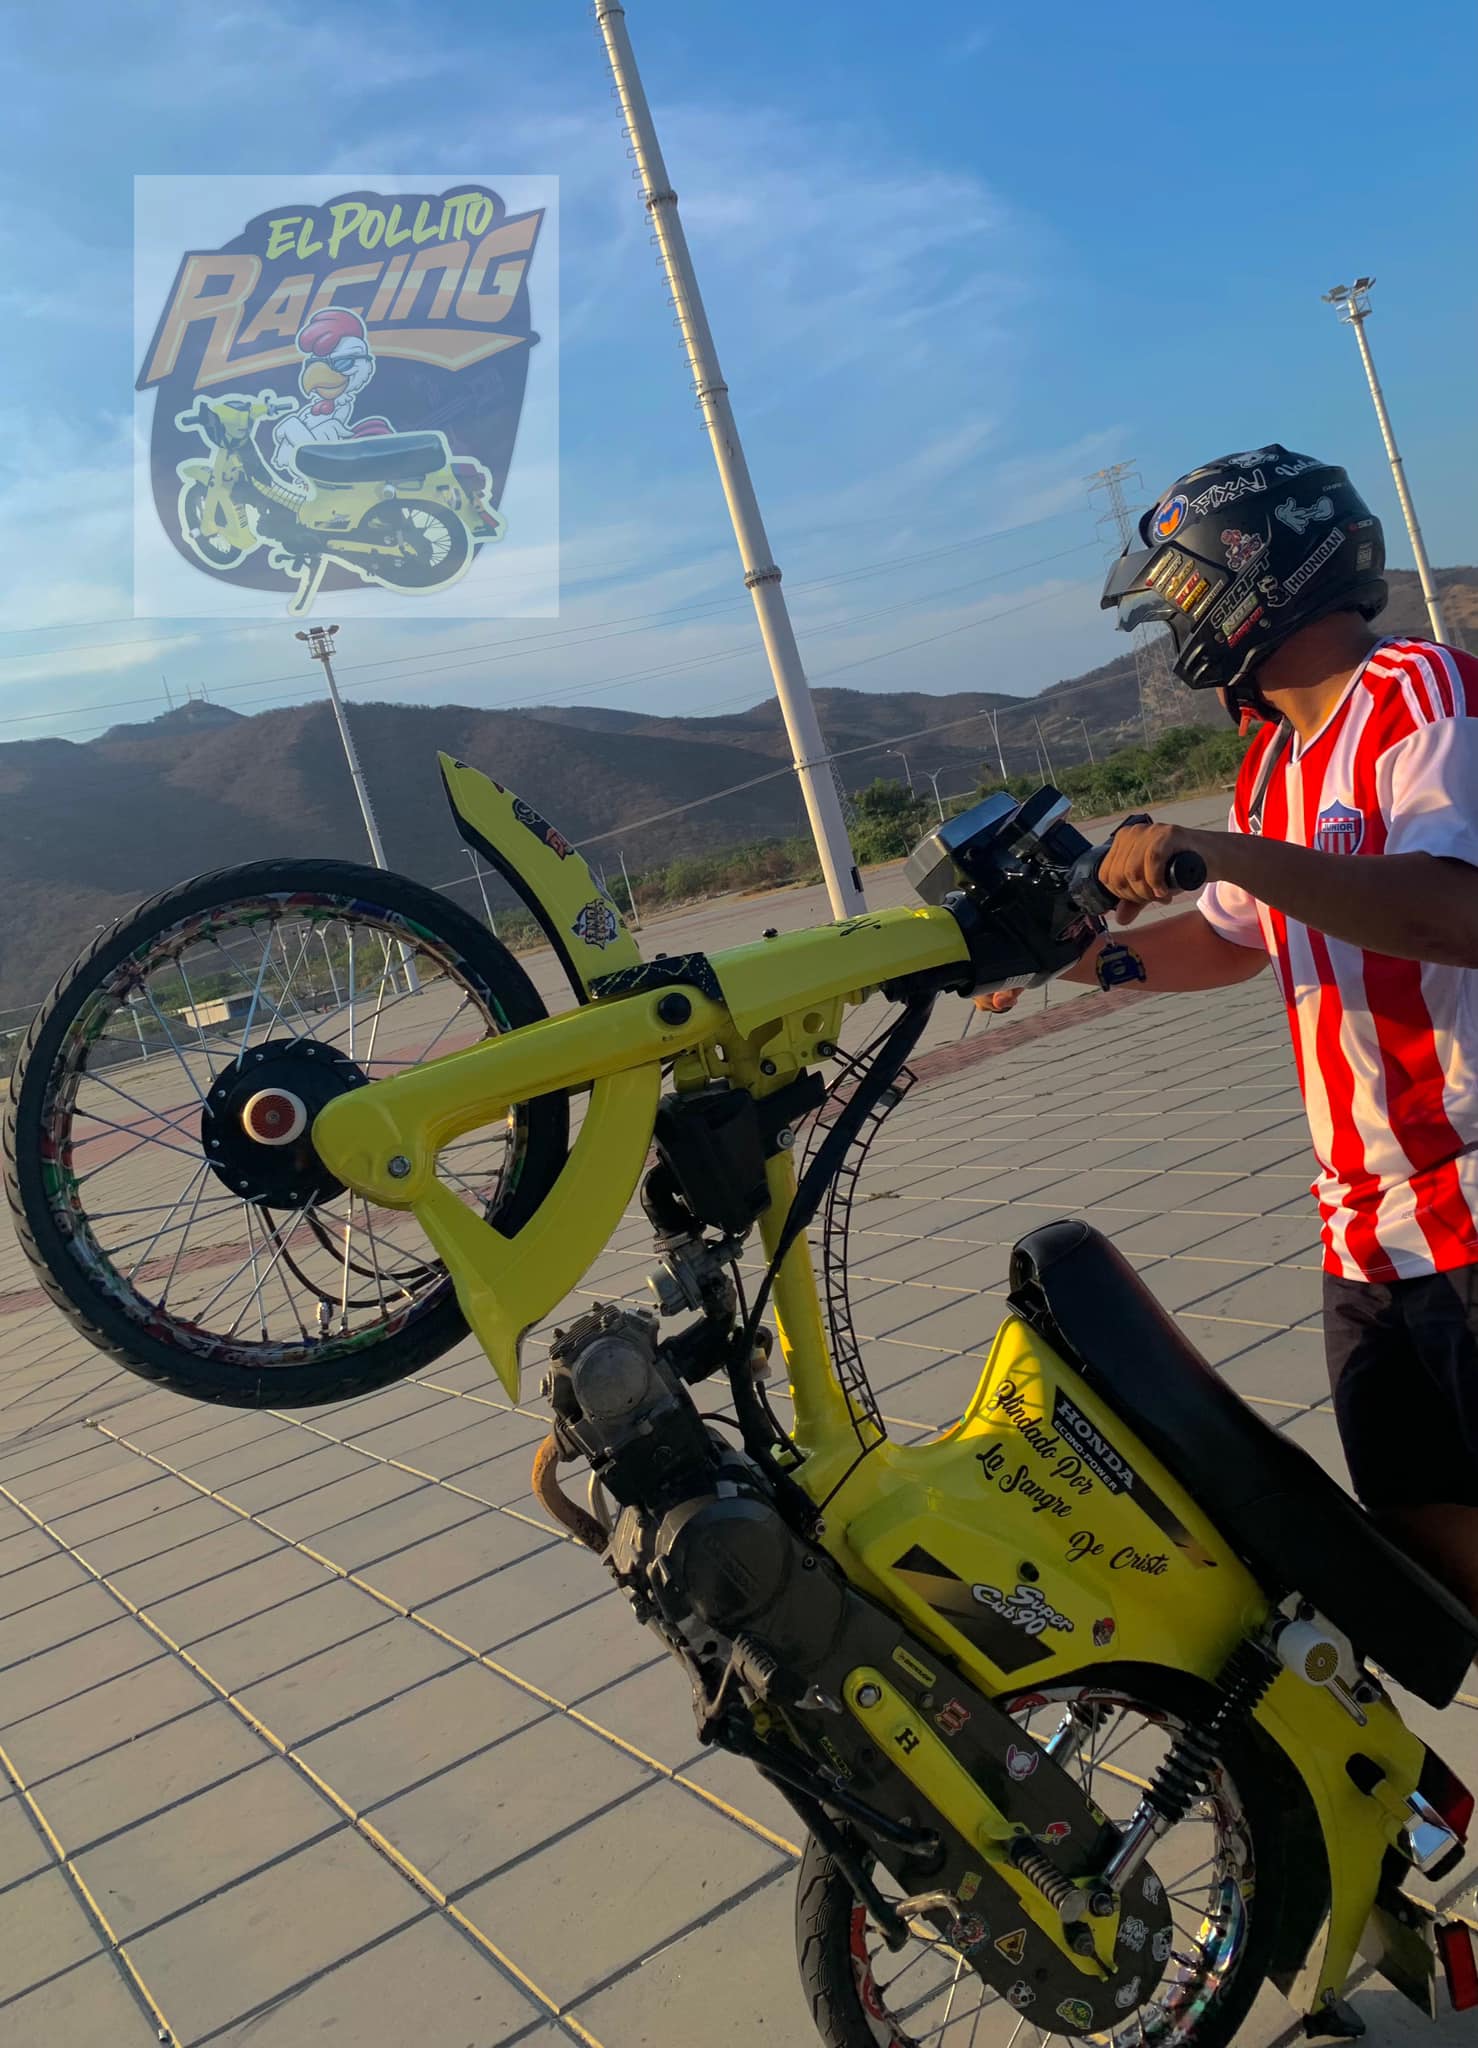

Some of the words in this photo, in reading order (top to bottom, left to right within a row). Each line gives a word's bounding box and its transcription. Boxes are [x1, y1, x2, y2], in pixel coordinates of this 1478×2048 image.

[1290, 530, 1343, 592] HOONIGAN
[1210, 549, 1271, 629] SHAFT
[1322, 822, 1354, 832] JUNIOR
[1056, 1400, 1136, 1490] HONDA
[976, 1443, 1004, 1480] La
[999, 1465, 1072, 1518] Sangre
[1050, 1457, 1093, 1496] Por
[1069, 1531, 1104, 1562] De
[1109, 1547, 1169, 1576] Cristo
[972, 1583, 1015, 1619] Cub
[1012, 1608, 1048, 1635] 90
[1008, 1584, 1074, 1632] Super
